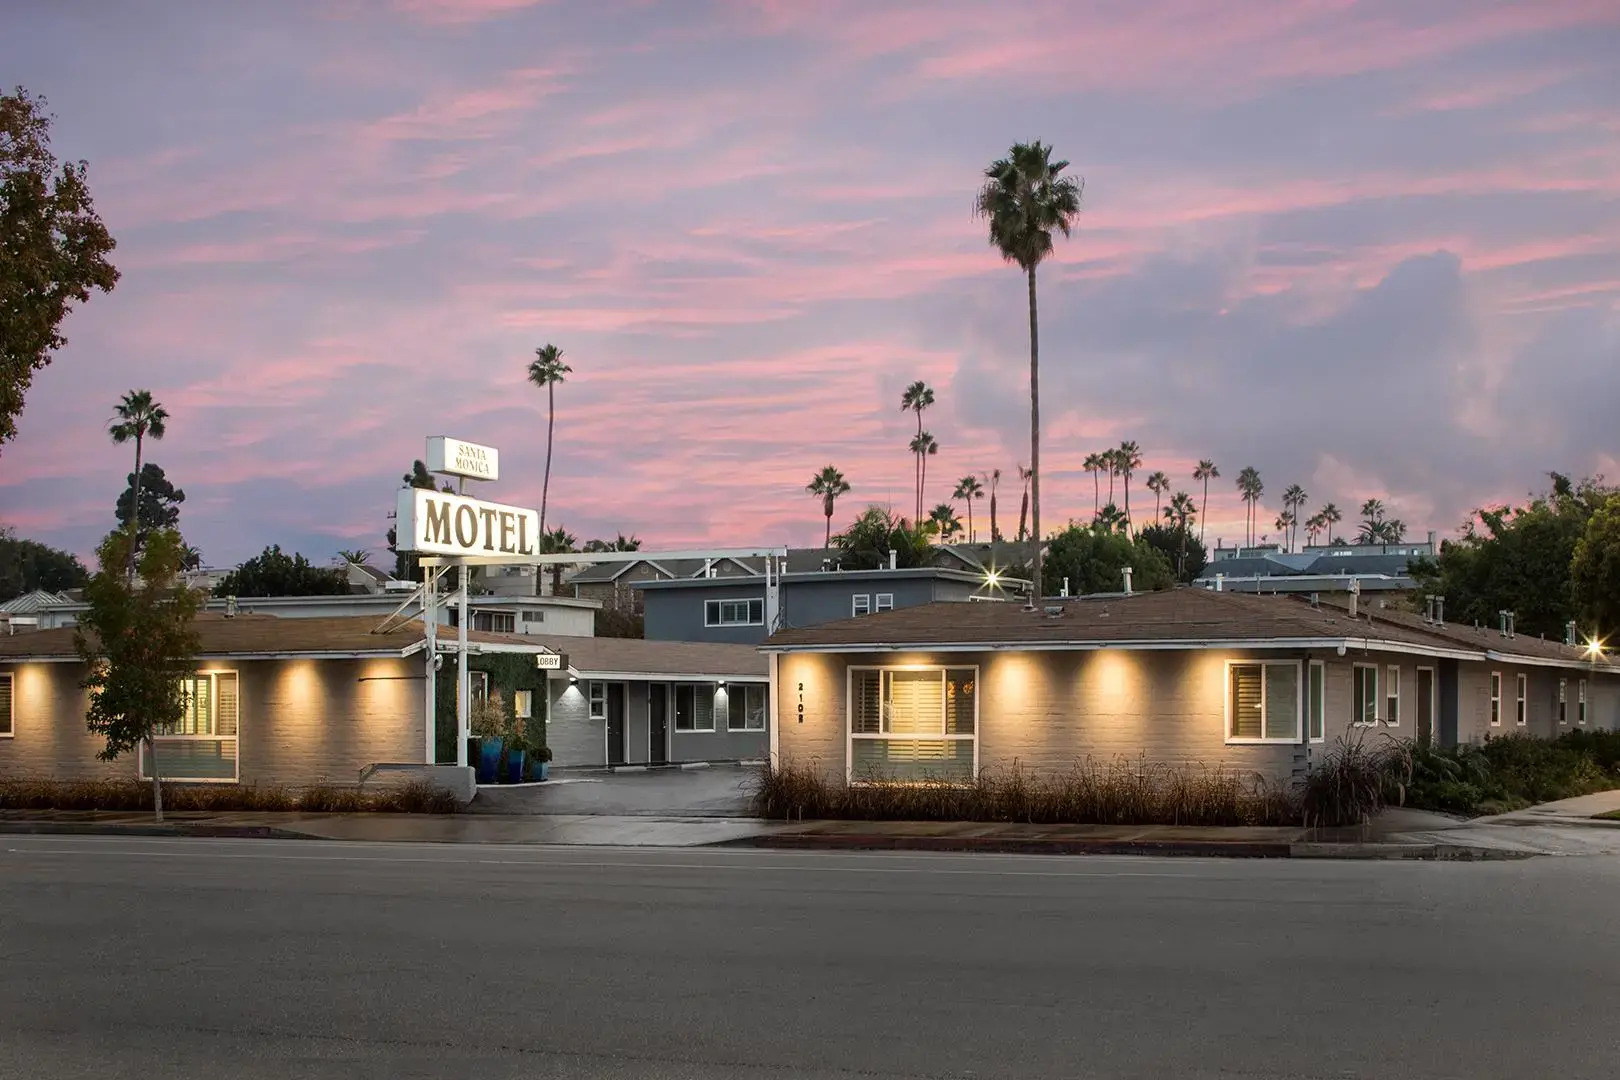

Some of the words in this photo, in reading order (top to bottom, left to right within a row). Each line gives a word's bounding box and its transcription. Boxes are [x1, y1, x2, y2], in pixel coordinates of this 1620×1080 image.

[458, 444, 487, 461] SANTA
[455, 457, 490, 475] MONICA
[424, 499, 533, 555] MOTEL
[538, 657, 559, 666] OBBY
